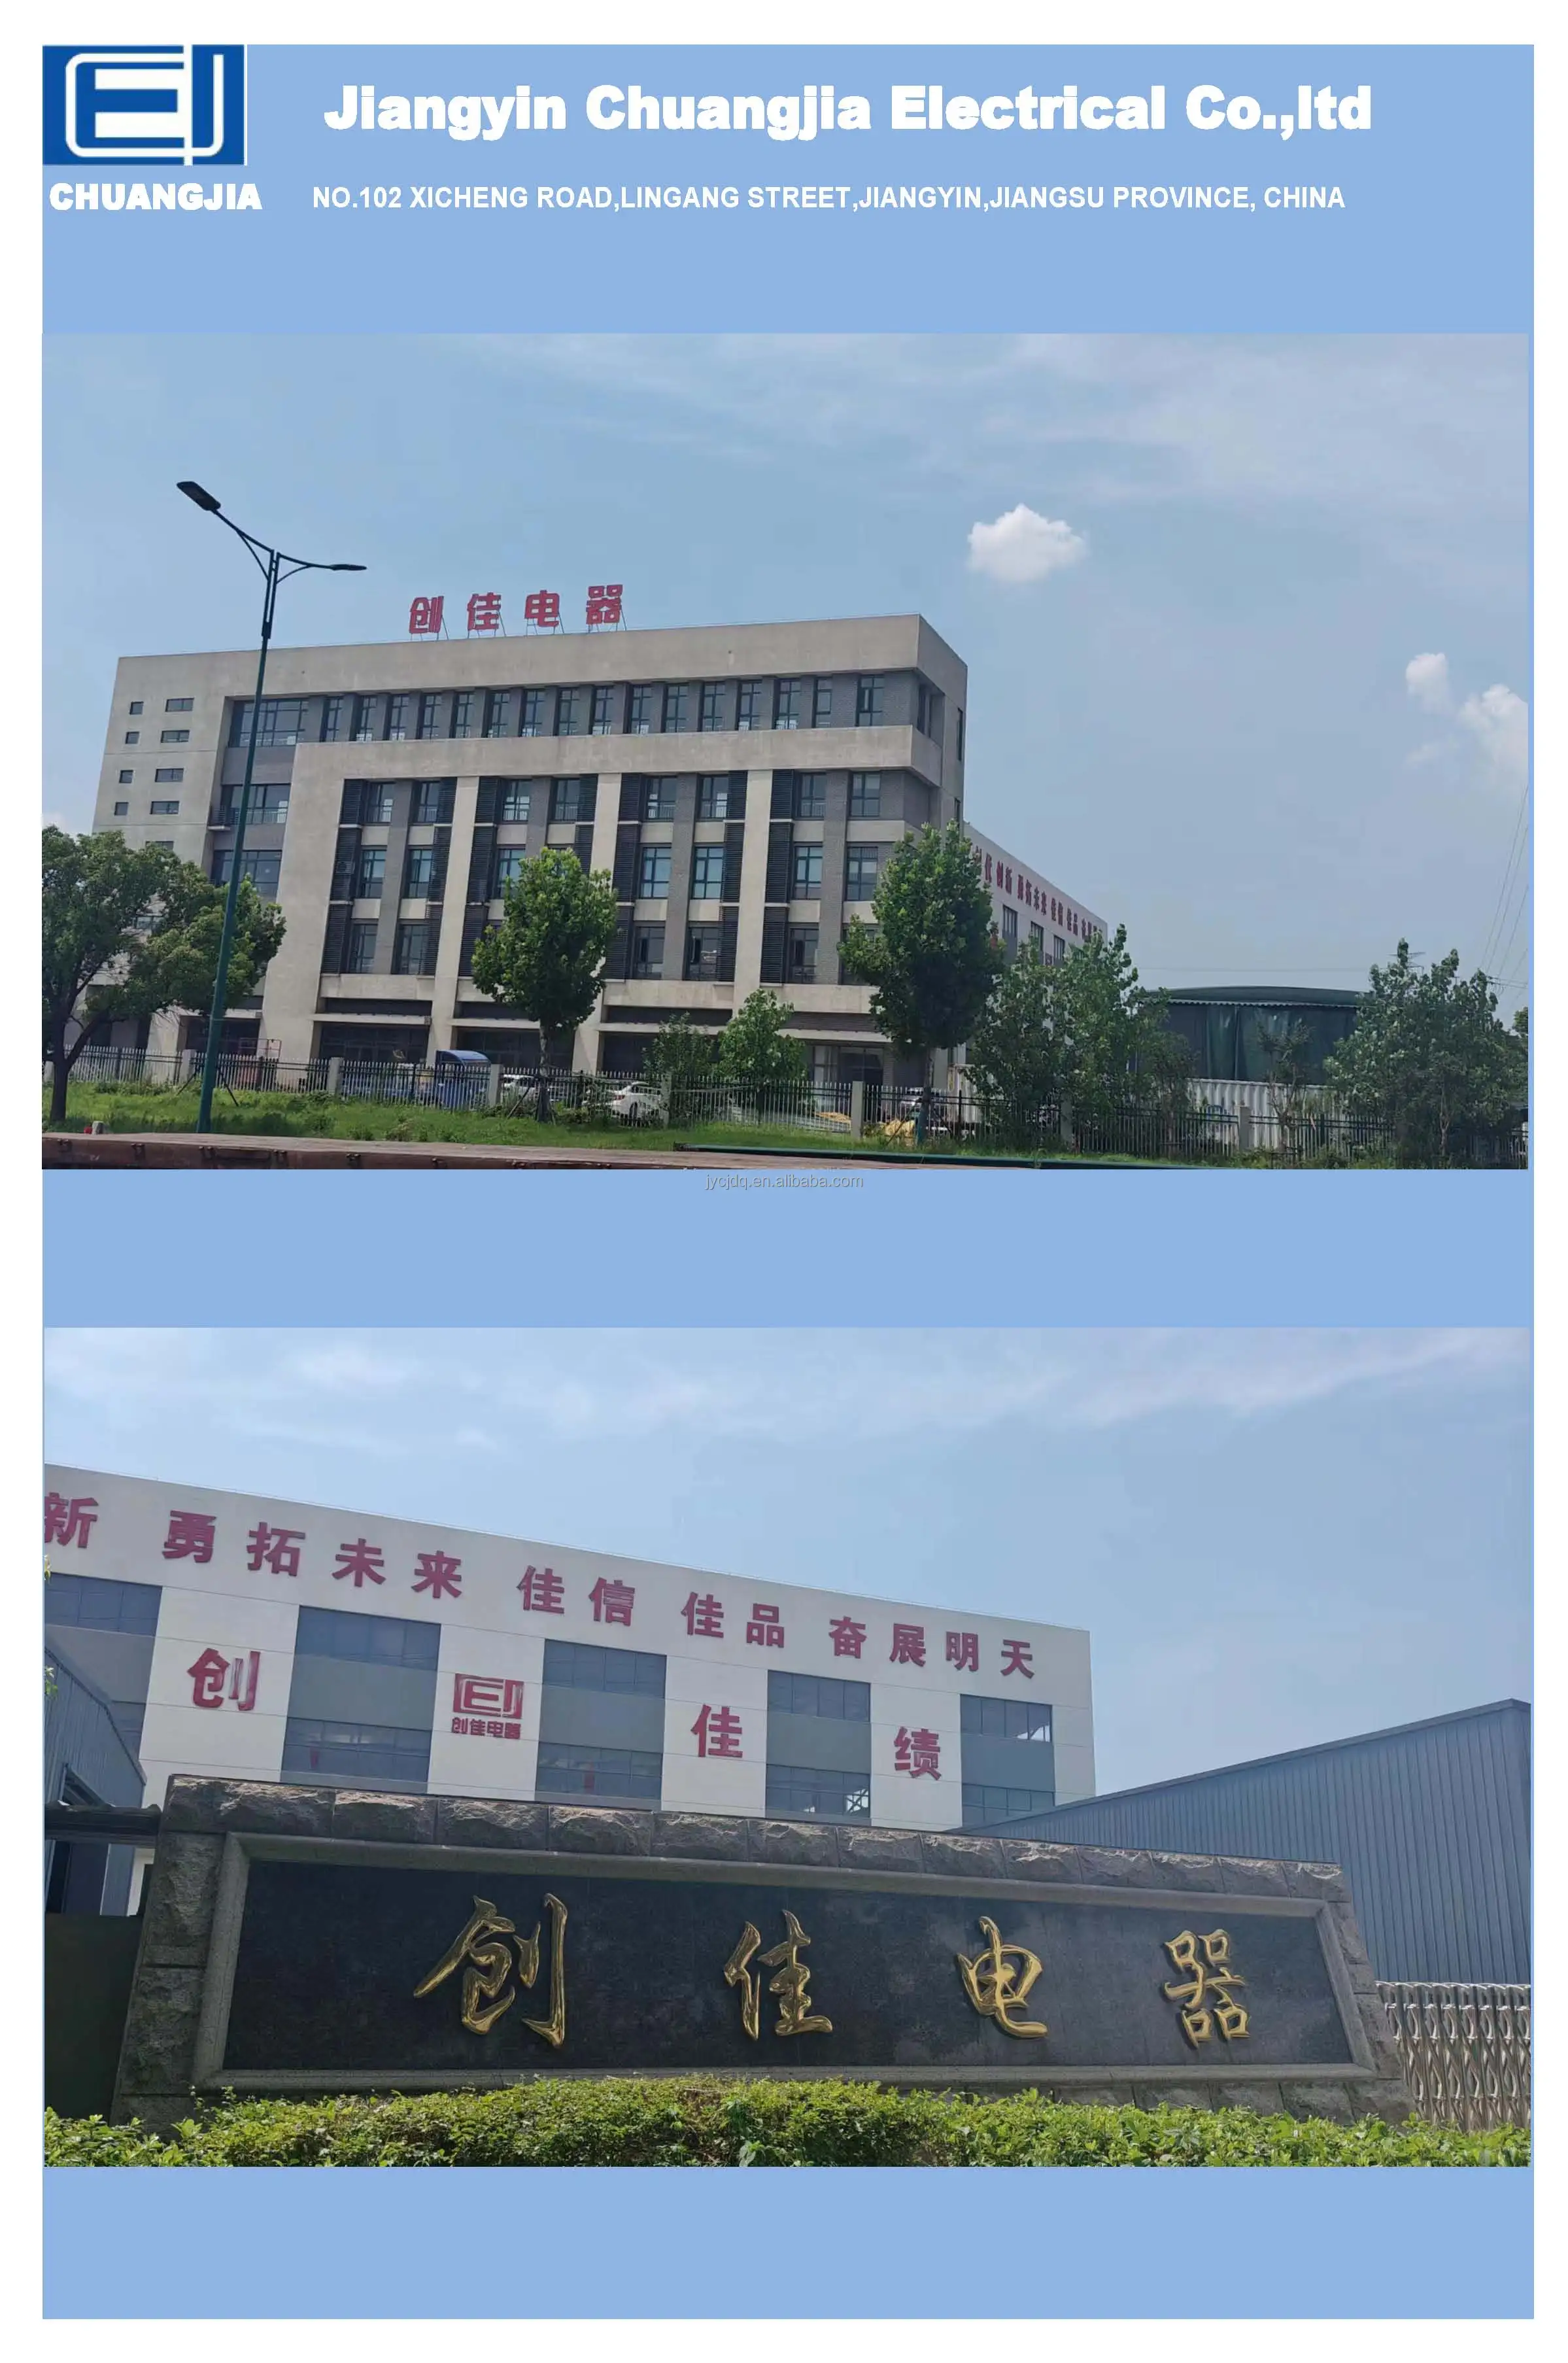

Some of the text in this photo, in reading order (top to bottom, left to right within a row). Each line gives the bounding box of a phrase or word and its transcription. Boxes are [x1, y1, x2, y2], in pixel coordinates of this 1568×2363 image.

[409, 584, 623, 634] 创佳电器
[44, 1492, 1036, 1680] 新 勇拓未来 佳信 佳品 奋展明天
[413, 1892, 1251, 2049] 创佳电器
